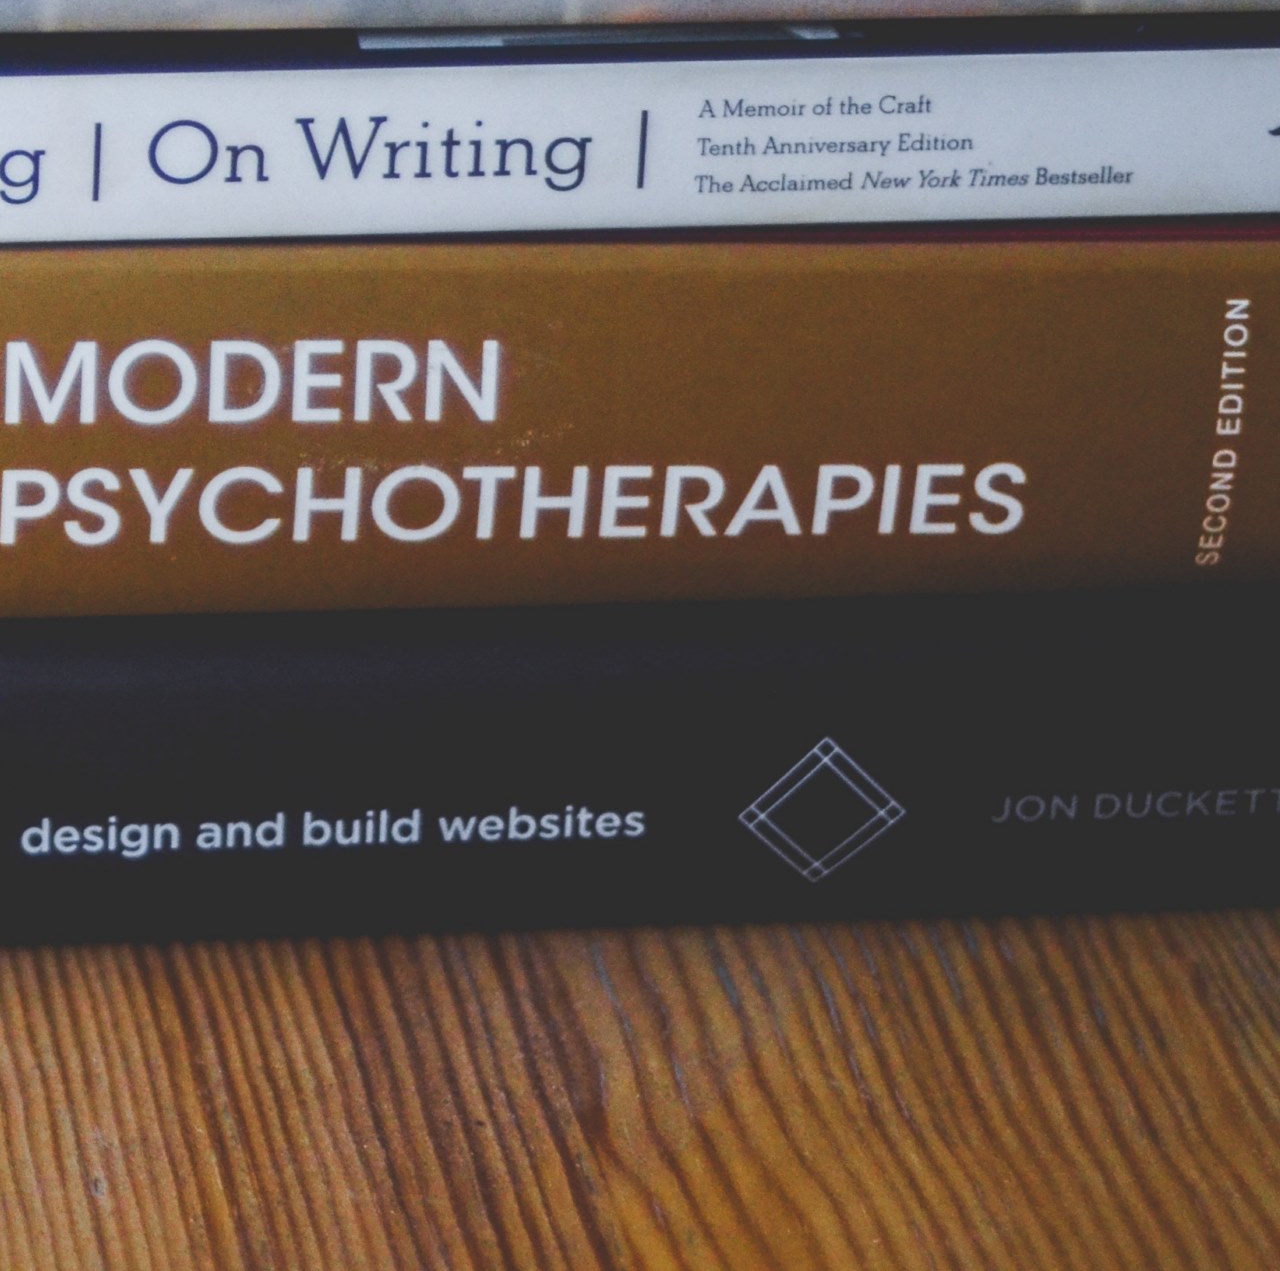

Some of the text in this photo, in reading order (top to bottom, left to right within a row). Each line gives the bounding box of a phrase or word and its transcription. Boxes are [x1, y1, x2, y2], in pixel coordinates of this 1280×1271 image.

[698, 94, 932, 119] A Memoir of the Craft
[148, 115, 593, 192] On Writing
[697, 132, 973, 159] Tenth Anniversary Edition
[695, 165, 1133, 194] The Acclaimed New York Times Bestseller
[4, 339, 499, 425] MODERN
[1195, 298, 1250, 566] SECOND EDITION
[991, 794, 1078, 824] JON
[21, 805, 645, 858] design and build websites
